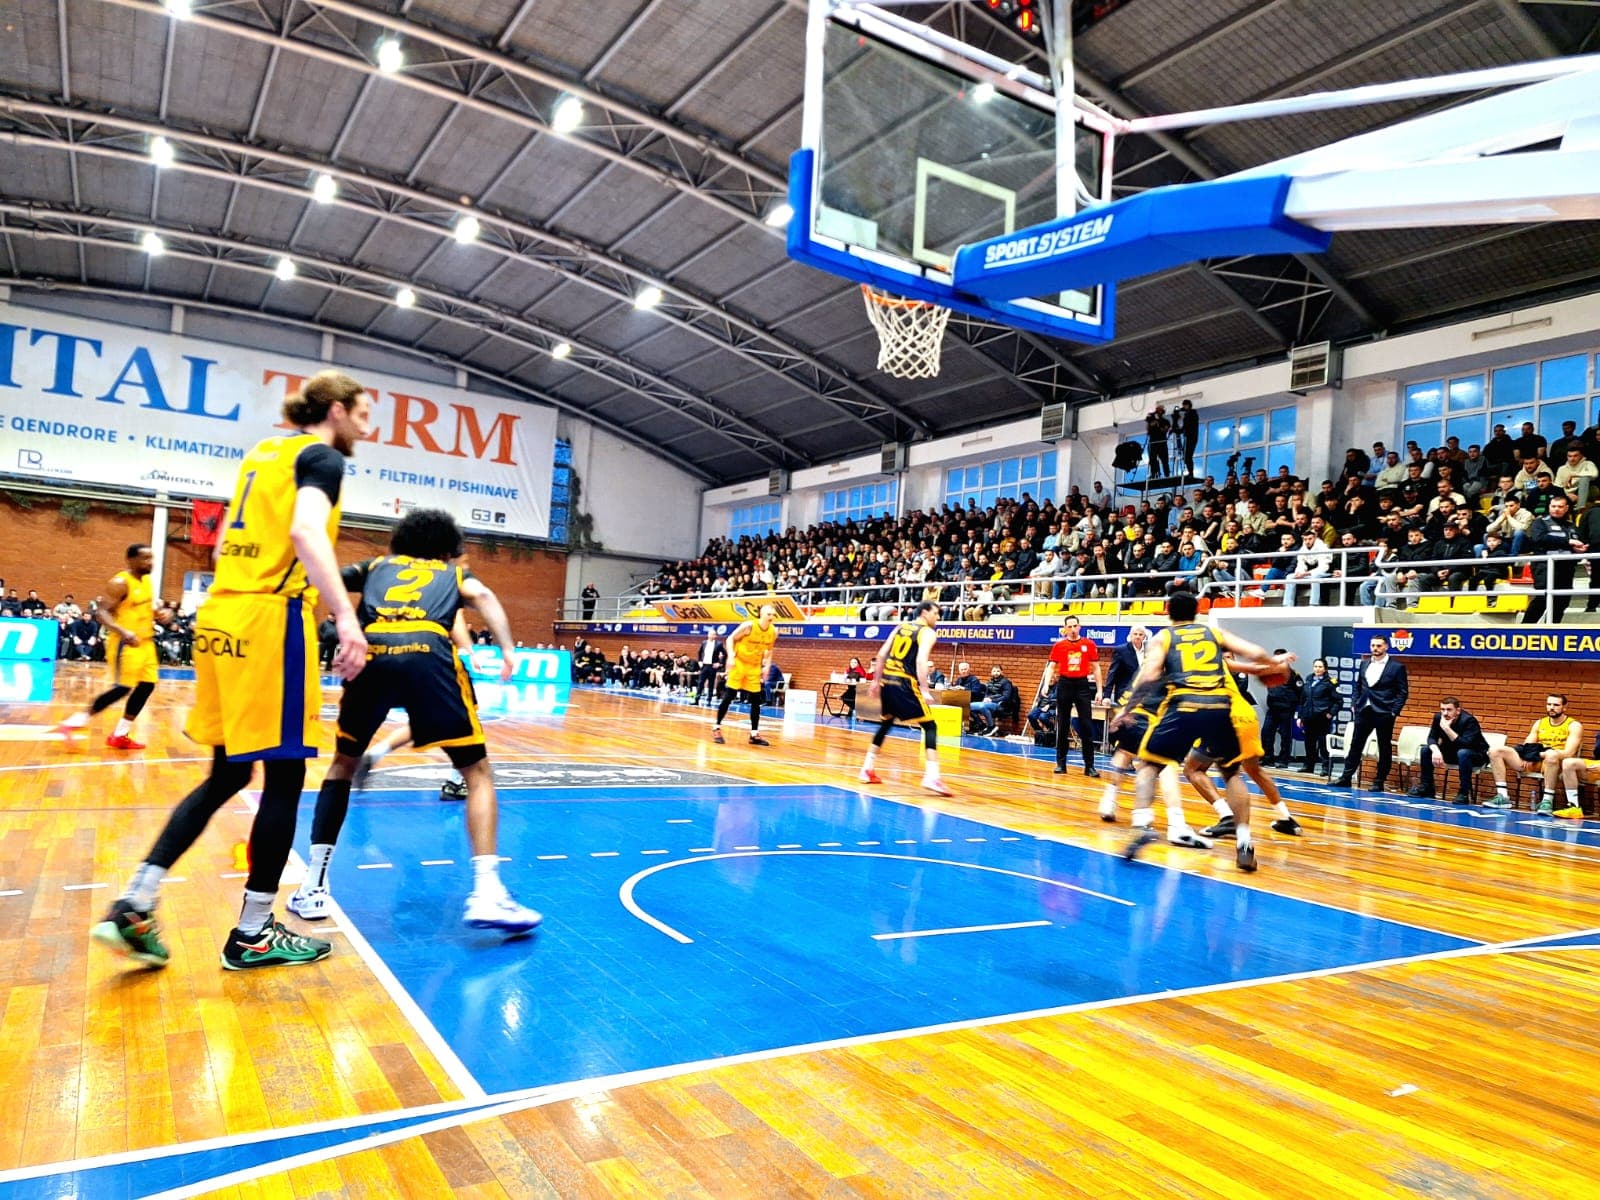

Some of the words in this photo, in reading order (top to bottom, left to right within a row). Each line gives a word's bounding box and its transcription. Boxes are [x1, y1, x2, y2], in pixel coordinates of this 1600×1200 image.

[263, 369, 521, 467] TRM
[11, 416, 118, 443] QENDRORE
[379, 468, 436, 488] FILTRIM
[448, 479, 519, 501] PISHINAVE
[384, 568, 434, 603] 2
[672, 604, 712, 620] Graniti
[936, 628, 967, 639] GOLDEN
[968, 628, 994, 640] EAGLE
[995, 629, 1014, 640] YLLI
[1429, 633, 1466, 650] K.B.
[1470, 634, 1558, 652] GOLDEN
[1175, 640, 1220, 673] 12
